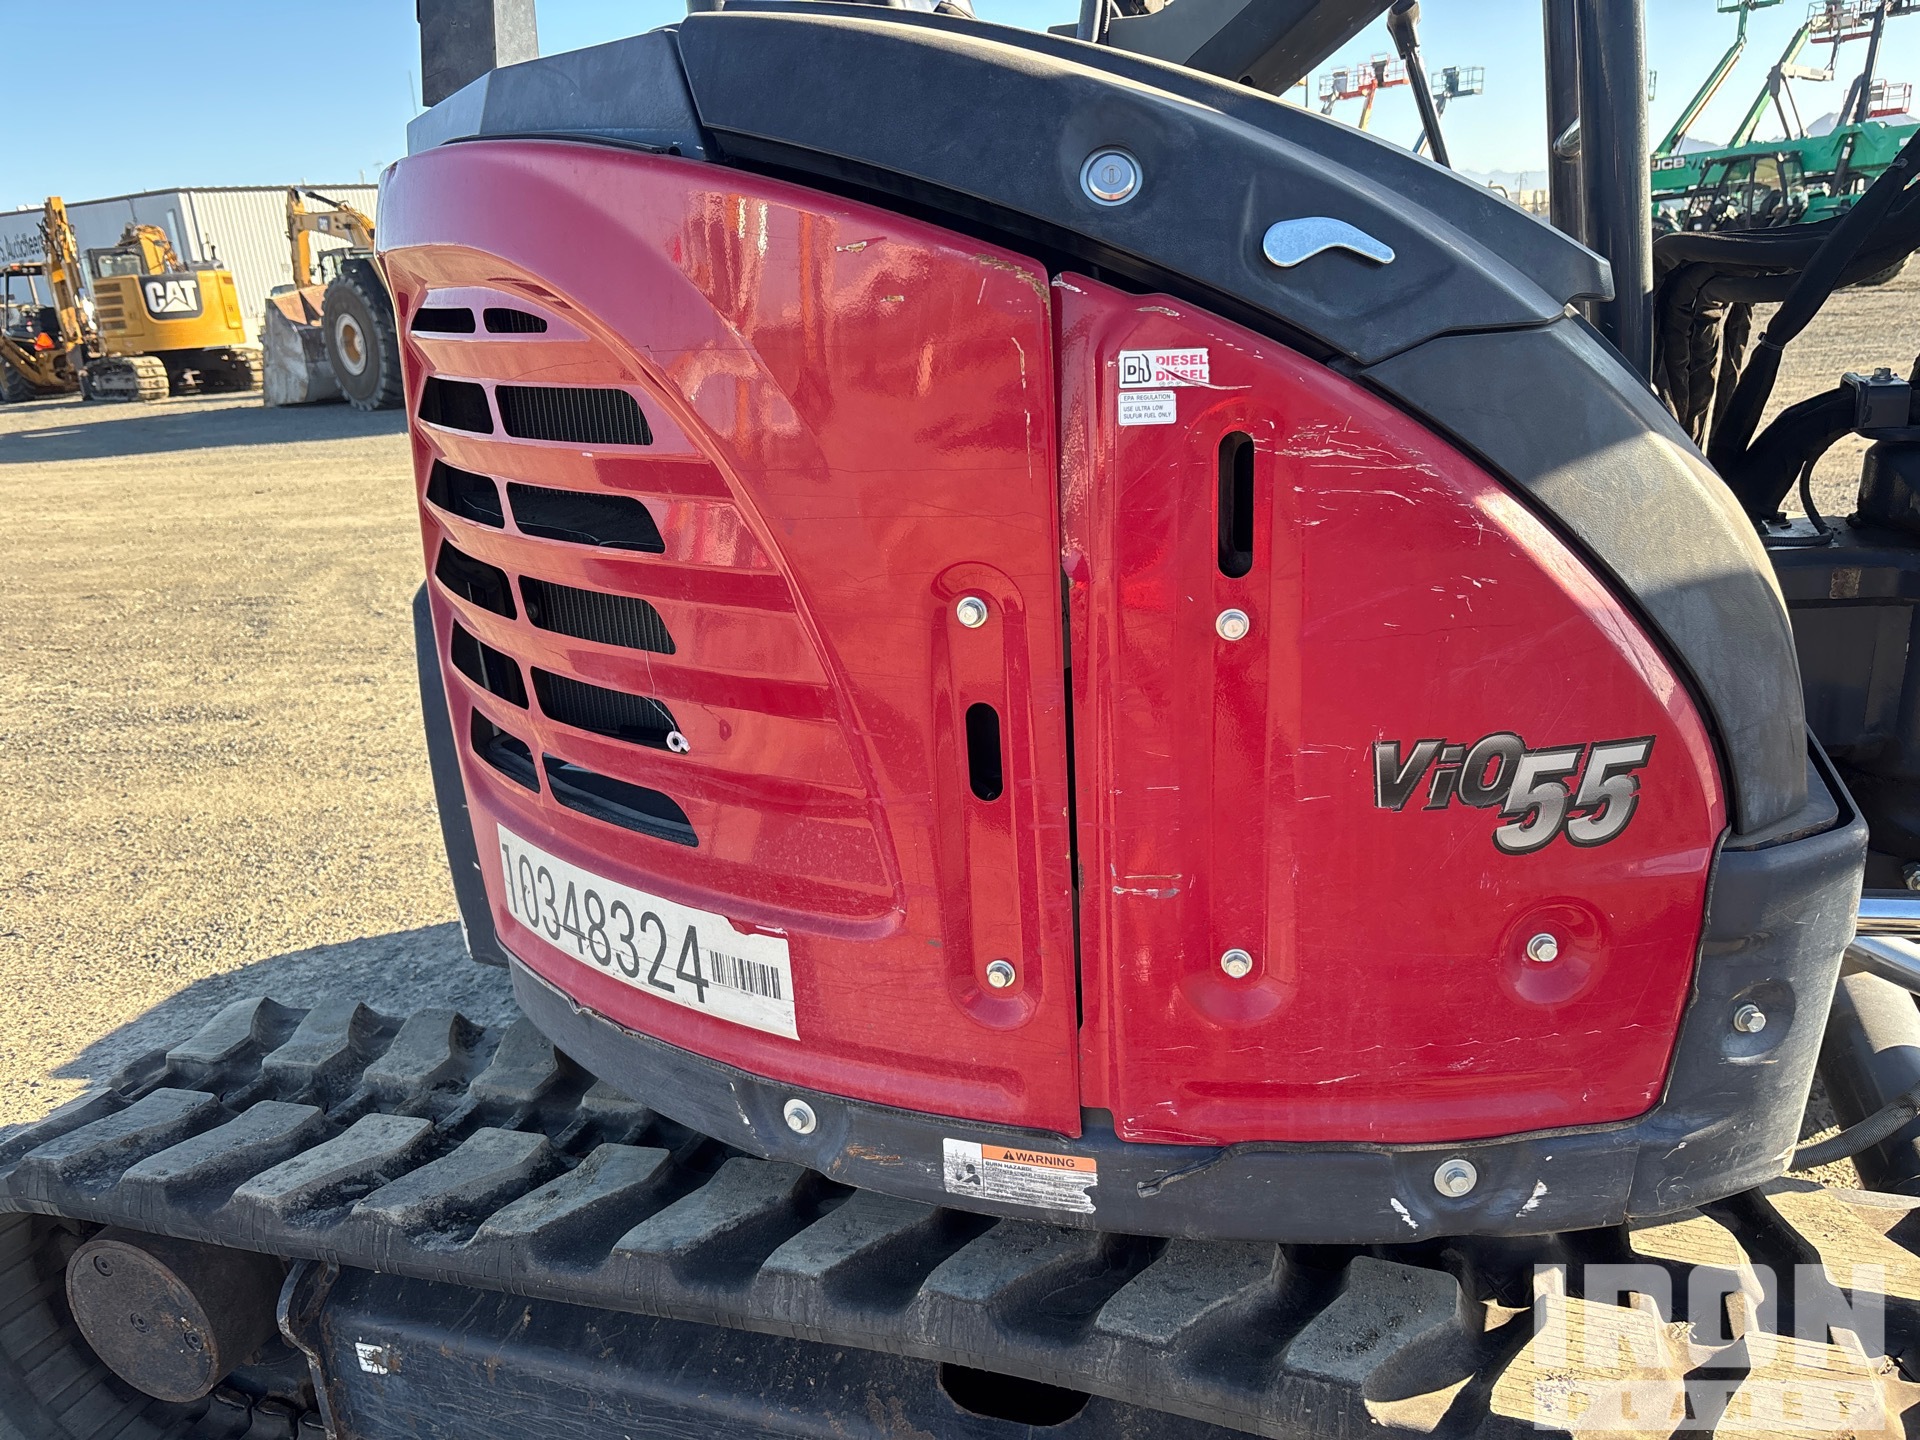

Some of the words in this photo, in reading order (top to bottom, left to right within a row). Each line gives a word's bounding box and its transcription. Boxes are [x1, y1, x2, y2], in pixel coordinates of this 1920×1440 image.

[145, 280, 198, 313] CAT
[1155, 354, 1207, 366] DIESEL
[501, 843, 710, 1004] 10348324
[1015, 1151, 1075, 1168] WARNING
